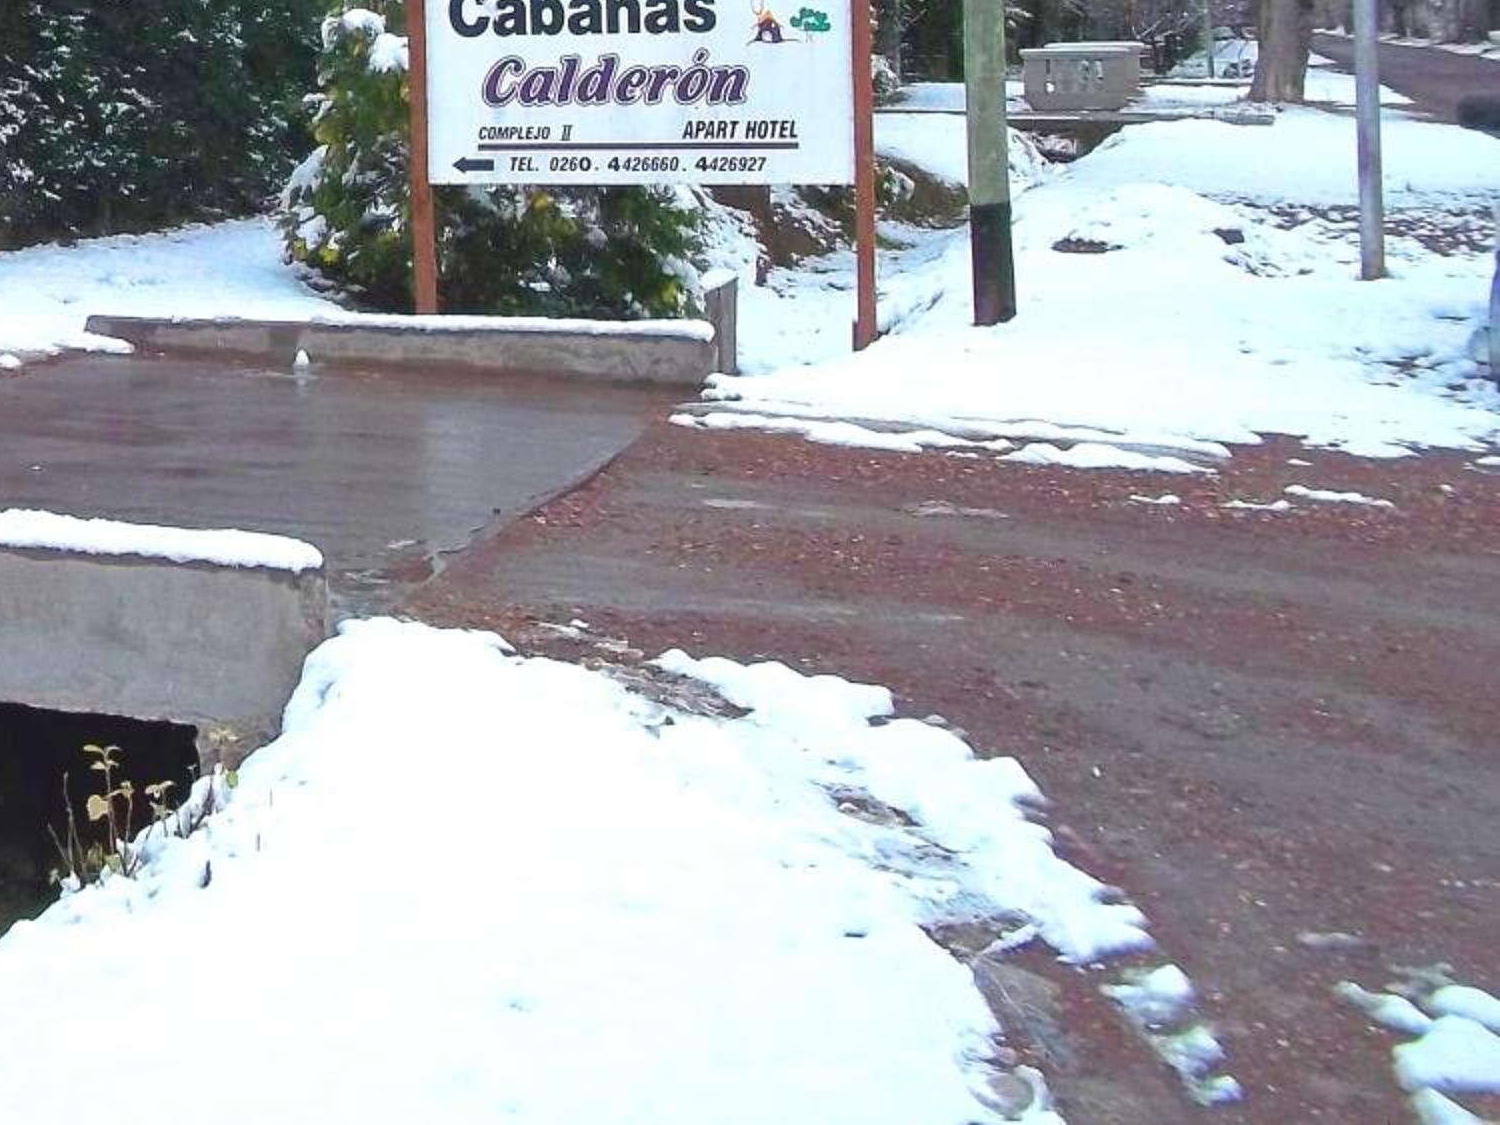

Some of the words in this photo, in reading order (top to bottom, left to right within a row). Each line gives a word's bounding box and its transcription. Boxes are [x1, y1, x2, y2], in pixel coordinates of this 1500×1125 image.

[482, 47, 750, 107] Calderón
[478, 126, 551, 140] COMPLEJO
[682, 120, 740, 139] APART
[745, 119, 799, 139] HOTEL
[509, 156, 540, 172] TEL.
[694, 156, 767, 172] 4426927
